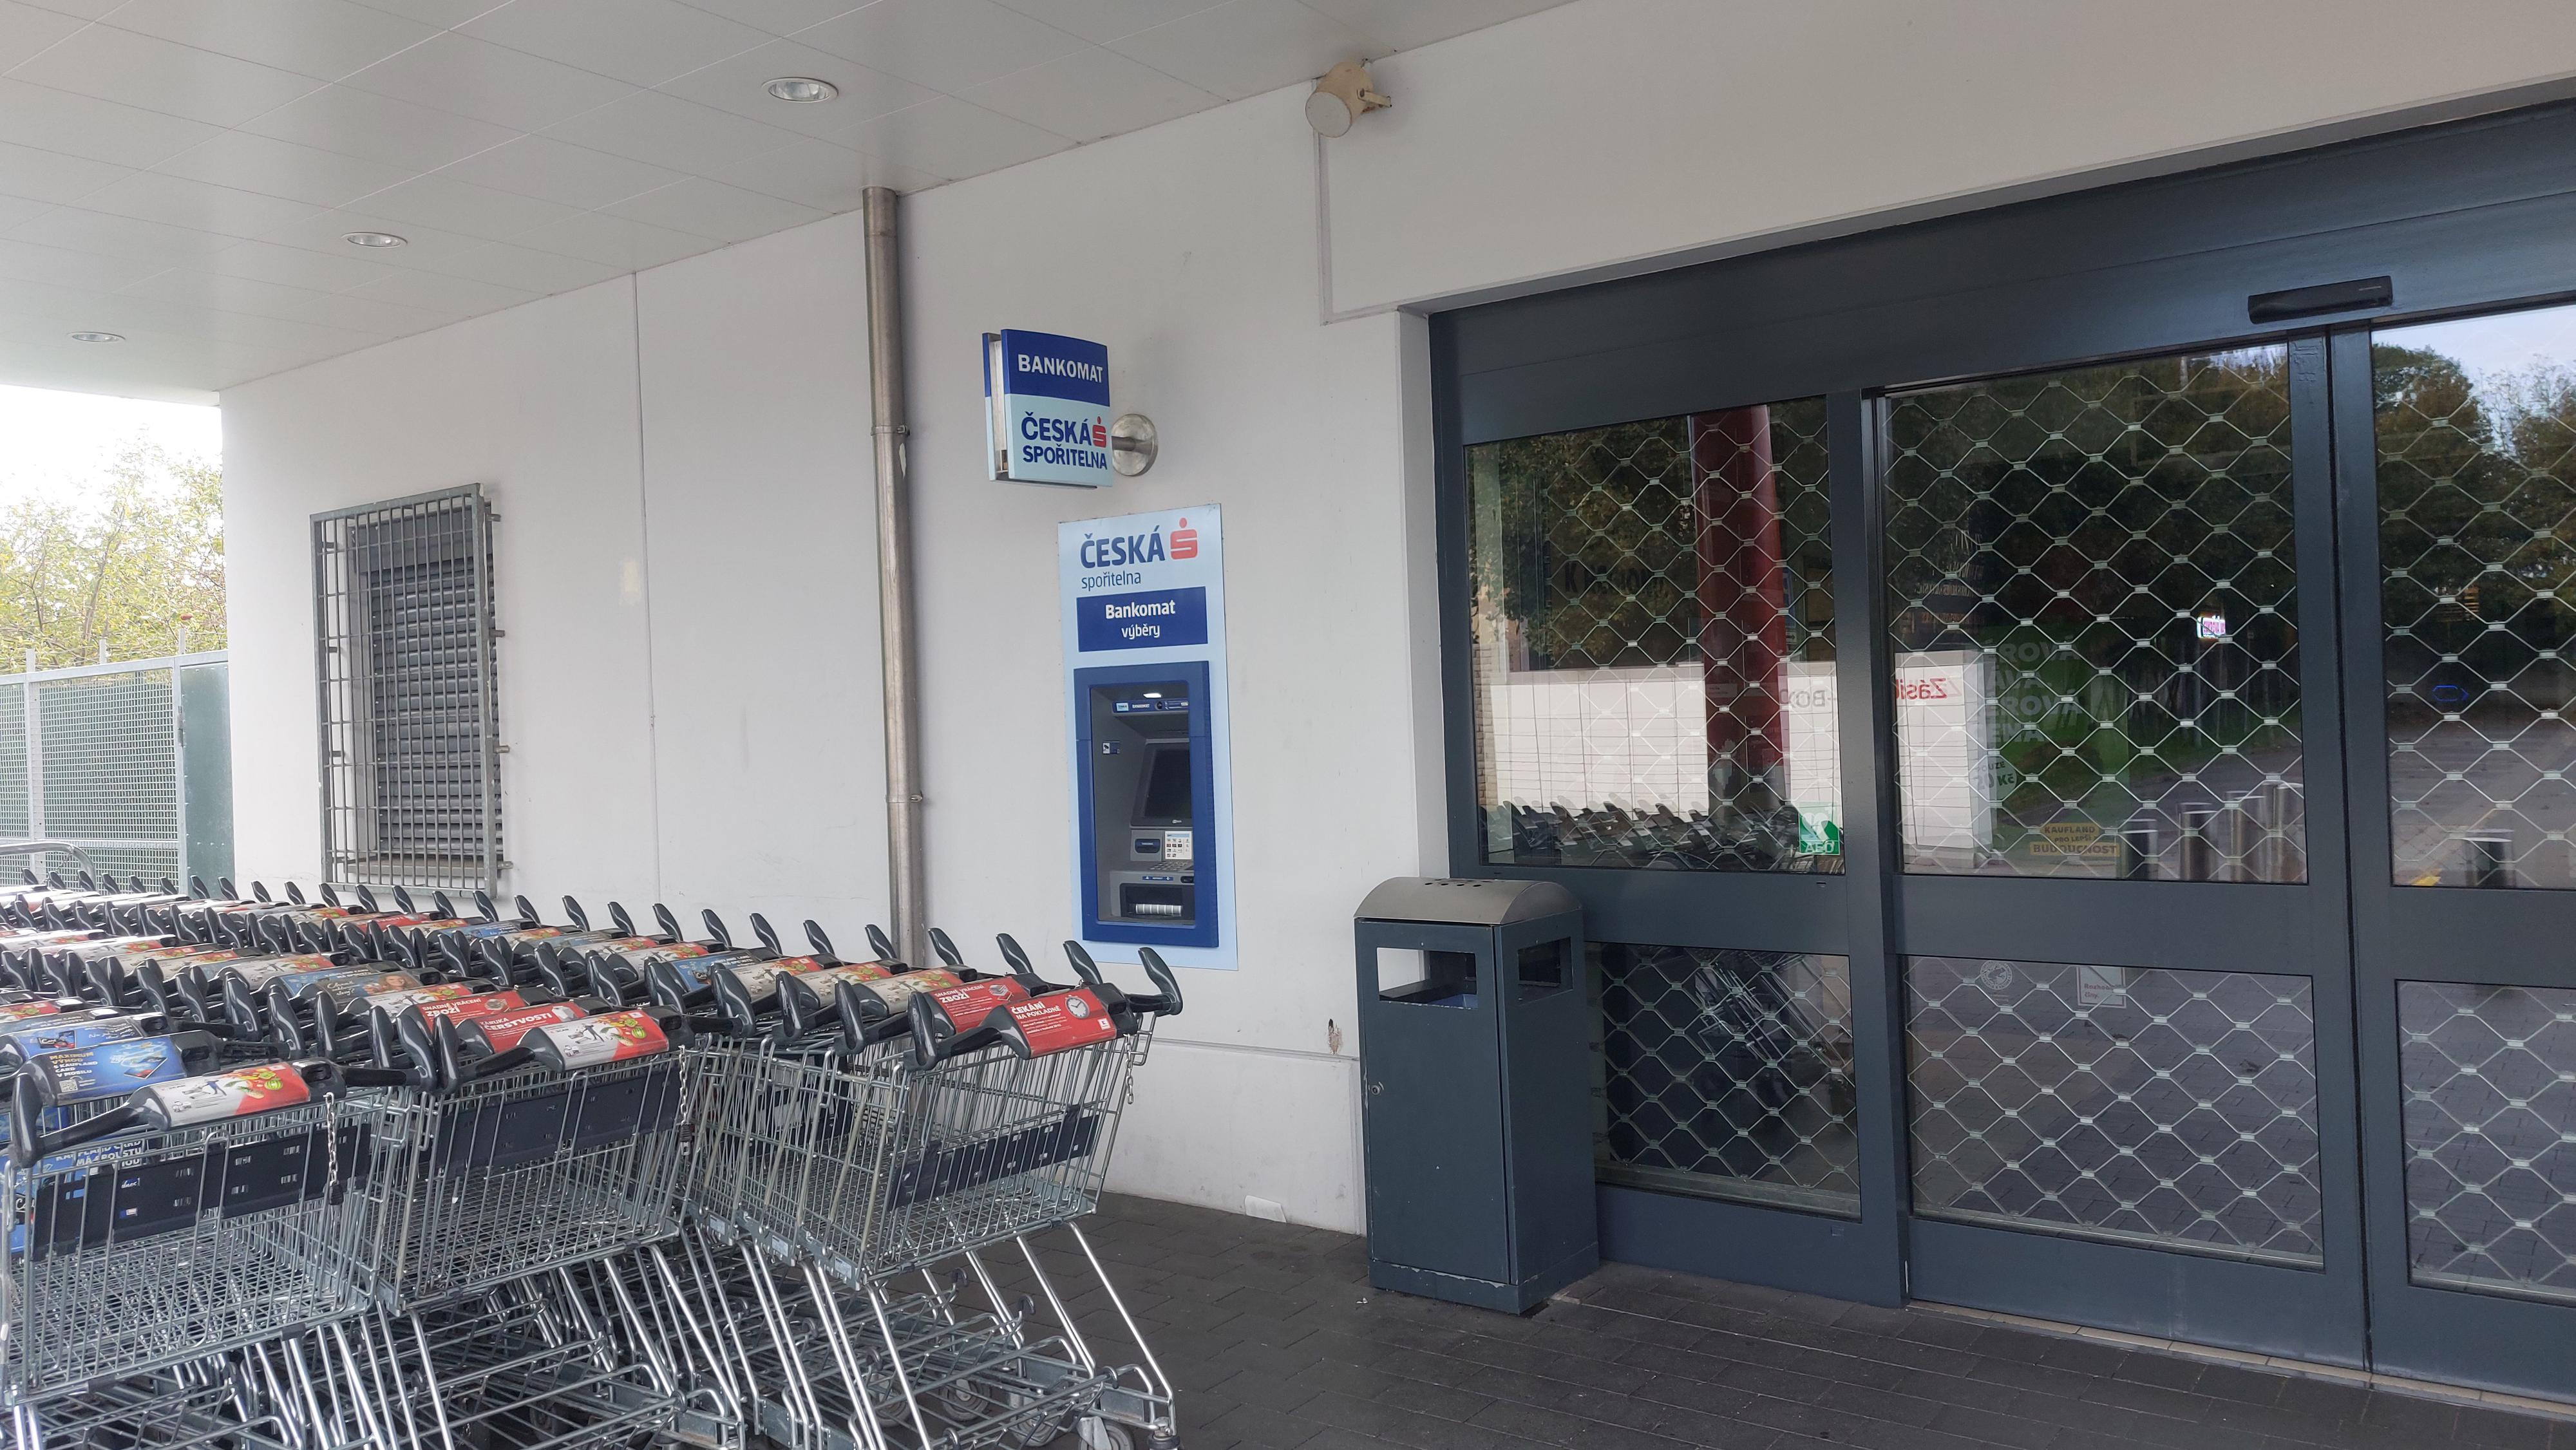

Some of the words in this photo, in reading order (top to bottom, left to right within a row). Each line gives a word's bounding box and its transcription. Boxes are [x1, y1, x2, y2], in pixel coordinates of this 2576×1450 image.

[1018, 353, 1104, 384] BANKOMAT
[1021, 411, 1092, 446] ČESKÁ
[1023, 443, 1108, 470] SPOŘITELNA
[1080, 525, 1166, 569] ČESKÁ
[1081, 570, 1142, 592] spořitelna
[1105, 599, 1176, 619] Bankomat
[1121, 621, 1160, 639] výběry
[1984, 634, 2081, 663] ROVÁ
[1984, 688, 2083, 717] ROVÁ
[1996, 773, 2015, 787] Kč
[2044, 825, 2096, 834] KAUFLAND
[2033, 843, 2117, 855] BUDOUCNOST
[958, 983, 985, 993] VRÁCENÍ
[451, 997, 482, 1007] VRÁCENÍ
[938, 992, 971, 1004] ZBOŽÍ
[1010, 1001, 1046, 1015] ČEKÁNÍ
[1015, 1012, 1028, 1021] NA
[1027, 1005, 1062, 1019] POKLADNĚ
[484, 1012, 553, 1031] ČERSTVOSTI
[50, 1051, 94, 1060] MAXIMUM
[59, 1060, 99, 1069] KAUFLAND
